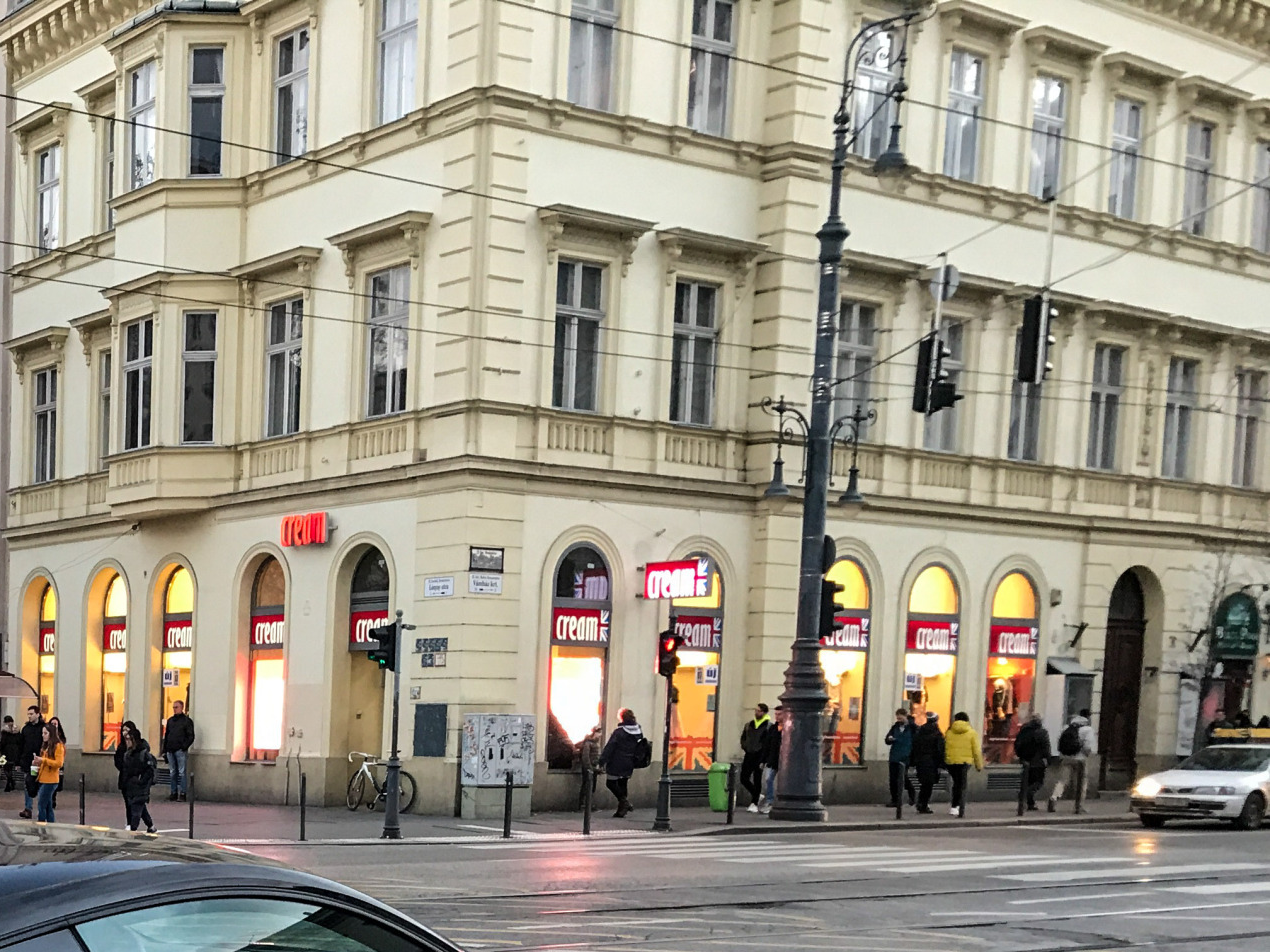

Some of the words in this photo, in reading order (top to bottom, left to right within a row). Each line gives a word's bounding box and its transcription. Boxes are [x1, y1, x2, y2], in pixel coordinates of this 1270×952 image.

[281, 511, 327, 547] cream
[647, 568, 696, 599] cream
[255, 621, 285, 645] cream
[556, 615, 599, 642] cream
[915, 627, 950, 651] cream
[998, 632, 1031, 655] cream
